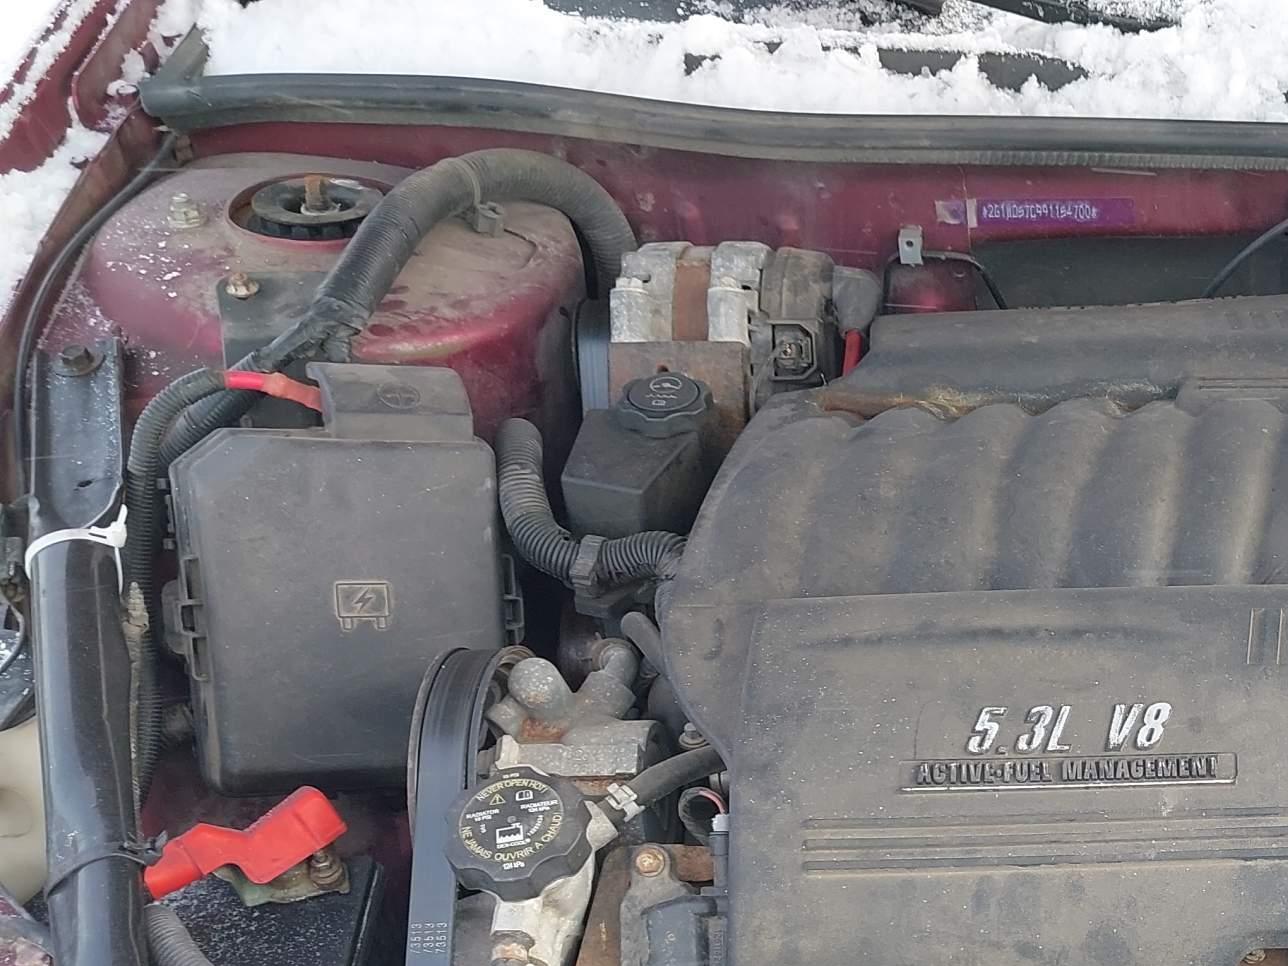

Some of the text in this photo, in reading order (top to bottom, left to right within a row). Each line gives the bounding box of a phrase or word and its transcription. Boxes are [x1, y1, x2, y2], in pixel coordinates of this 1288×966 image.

[967, 702, 1172, 754] 5.3L V8
[1060, 755, 1219, 781] MANAGEMENT
[475, 779, 549, 802] NEVER OPEN HOT!
[462, 826, 473, 839] NE
[465, 838, 493, 860] JAMAIS
[494, 846, 537, 861] OUVRIR
